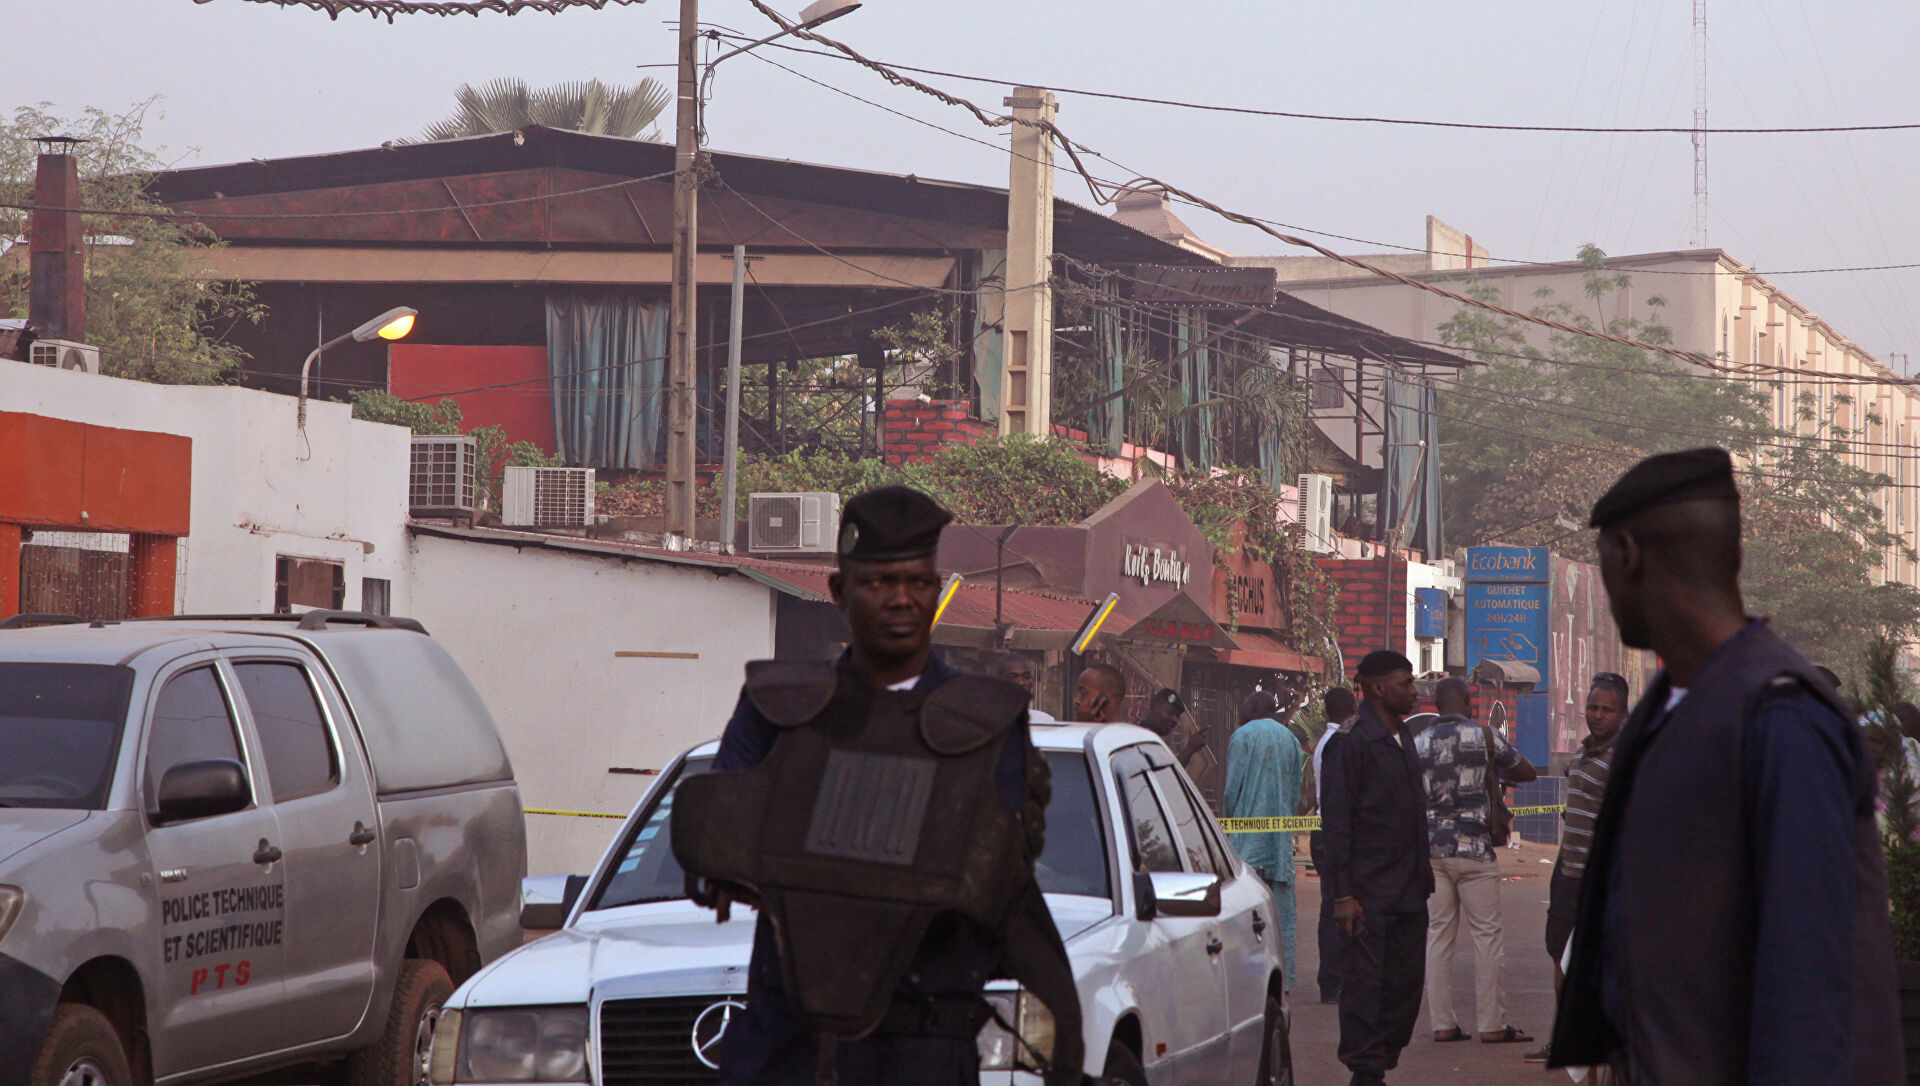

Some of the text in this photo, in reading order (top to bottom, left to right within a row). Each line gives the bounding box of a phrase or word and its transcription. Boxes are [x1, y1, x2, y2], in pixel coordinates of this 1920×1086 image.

[1471, 547, 1537, 570] Ecobank
[1226, 575, 1264, 616] CCHUS
[1487, 585, 1527, 595] GUICHET
[1474, 599, 1541, 610] AUTOMATIQUE
[1231, 819, 1270, 830] TECHNIQUE
[1272, 819, 1281, 829] ET
[162, 884, 283, 925] POLICE TECHNIQUE
[164, 920, 282, 963] ET SCIENTIFIQUE
